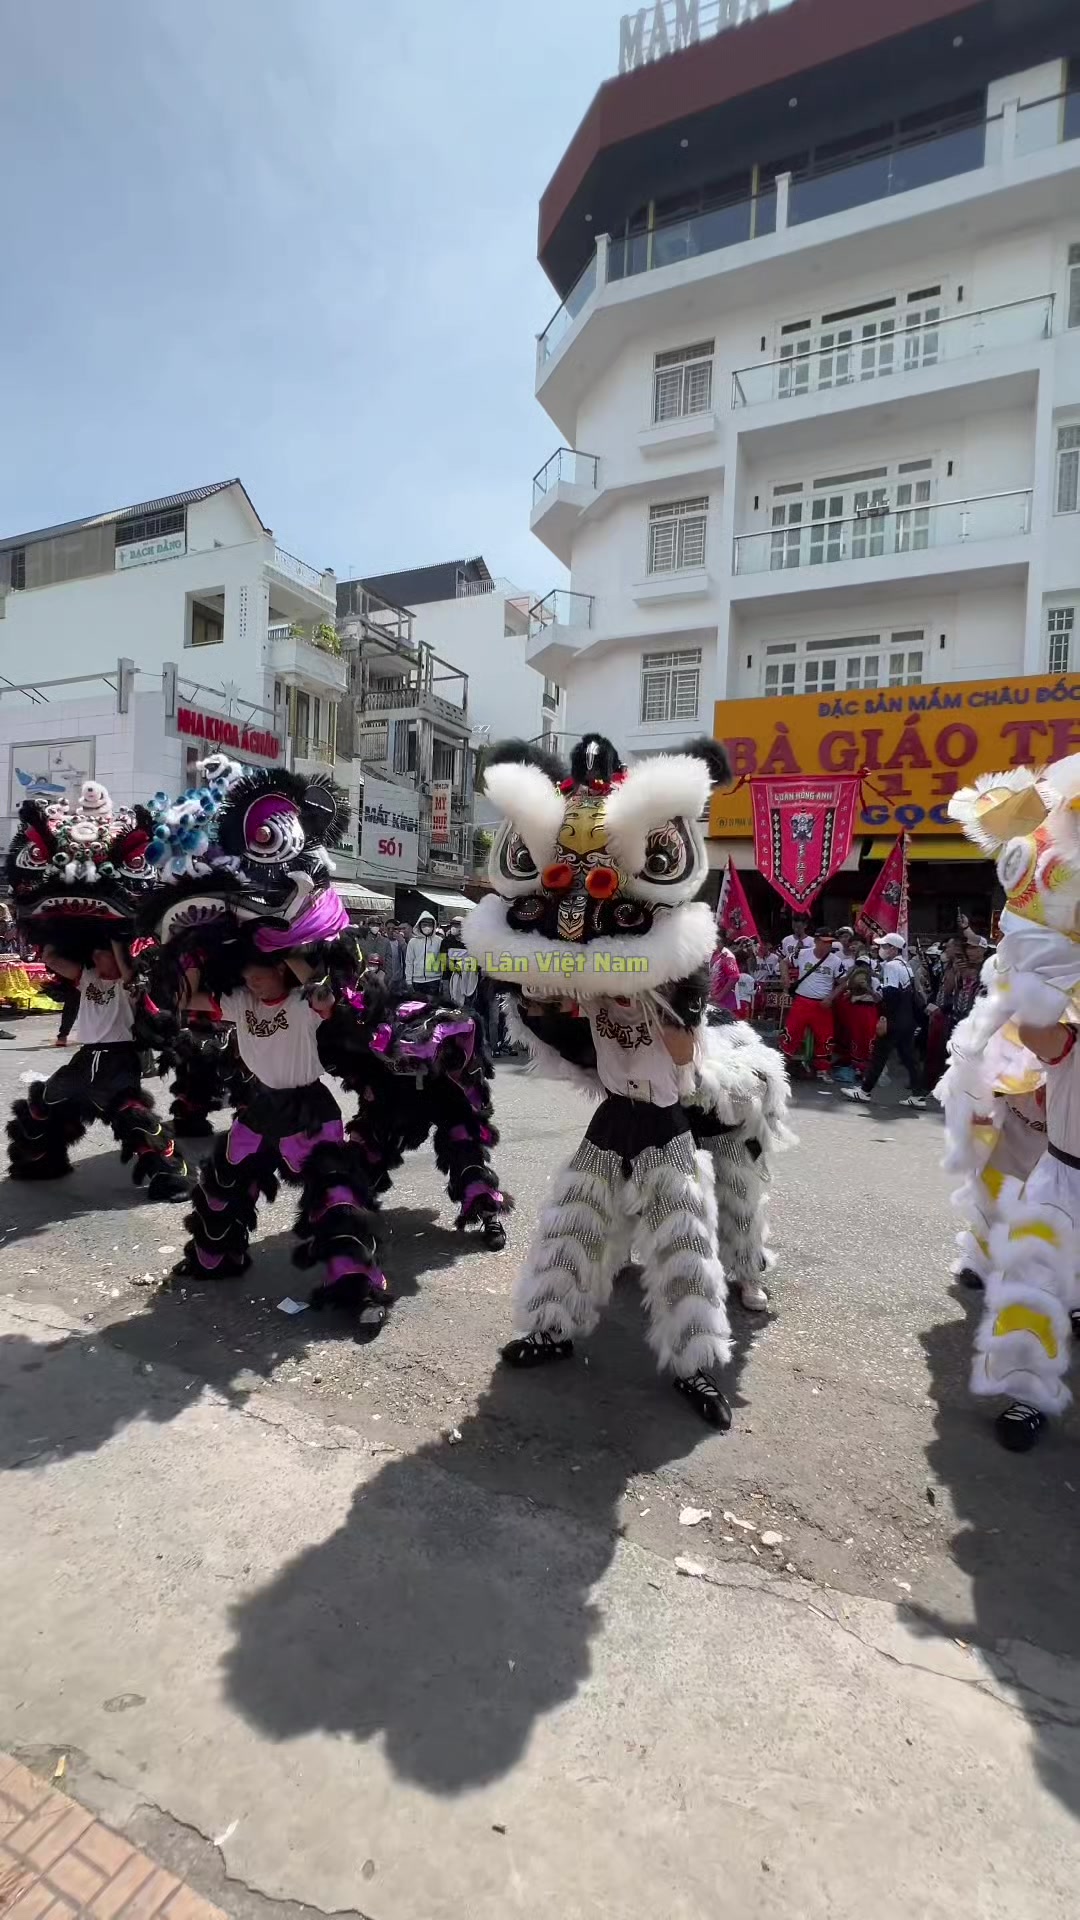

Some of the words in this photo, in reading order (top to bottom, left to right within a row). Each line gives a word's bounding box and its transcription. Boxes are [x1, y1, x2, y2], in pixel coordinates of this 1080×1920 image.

[818, 699, 860, 719] ĐẶC
[865, 692, 903, 714] SẢN
[908, 687, 963, 712] MẮM
[968, 685, 1030, 708] CHÂU
[178, 707, 204, 738] NHA
[205, 716, 240, 748] KHOA
[250, 731, 279, 760] CHÂU
[722, 722, 801, 777] BÀ
[818, 713, 978, 772] GIÁO
[398, 842, 403, 858] 1
